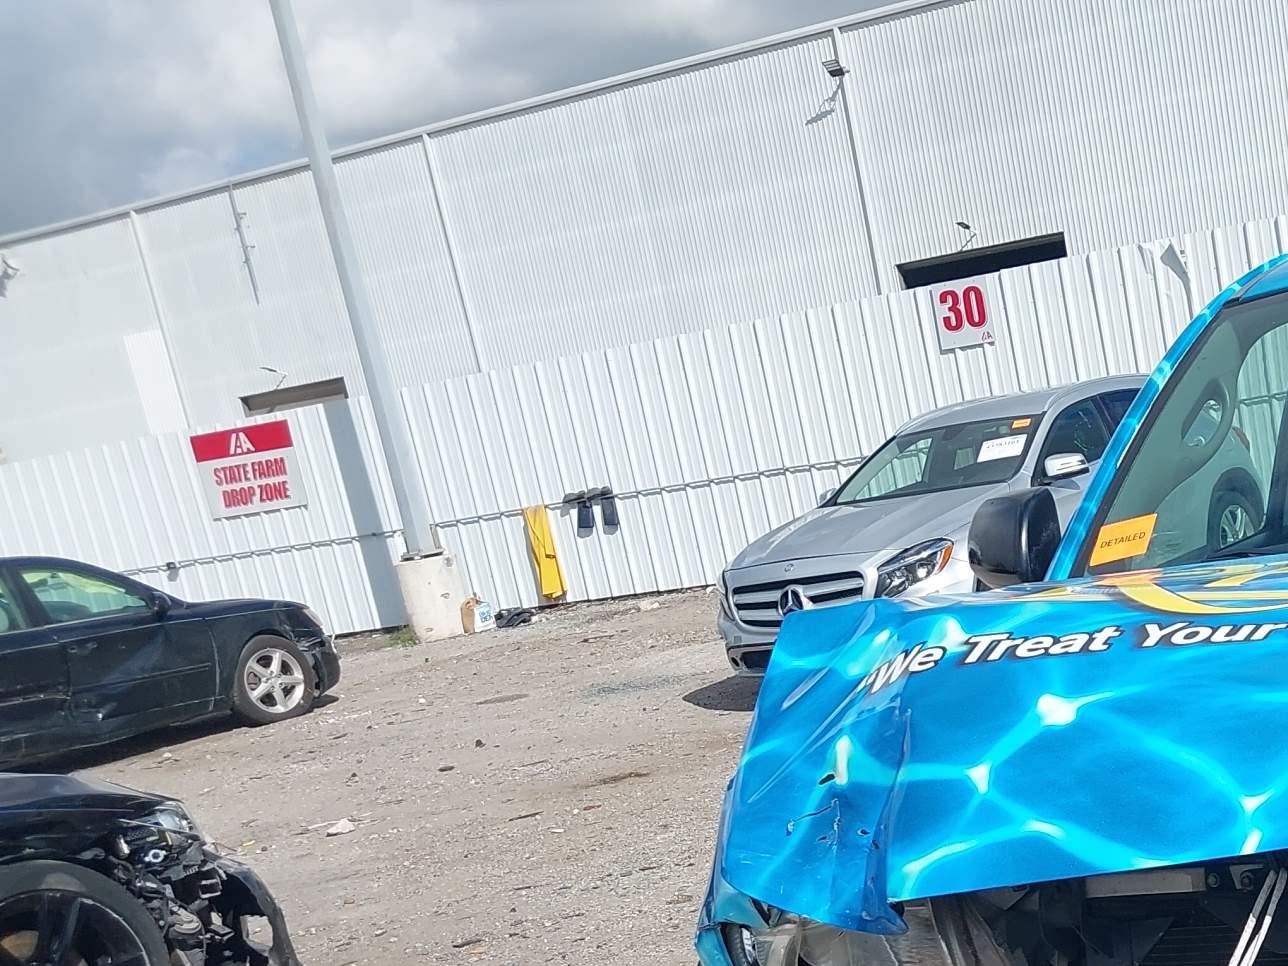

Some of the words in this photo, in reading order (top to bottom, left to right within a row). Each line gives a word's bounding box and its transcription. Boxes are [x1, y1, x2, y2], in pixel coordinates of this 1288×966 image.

[939, 285, 986, 331] 30
[213, 463, 251, 487] STATE
[251, 456, 288, 481] FARM
[222, 485, 257, 509] DROP
[257, 480, 291, 503] ZONE
[1100, 531, 1146, 549] DETAILED
[963, 626, 1121, 666] Treat
[1141, 622, 1288, 648] Your
